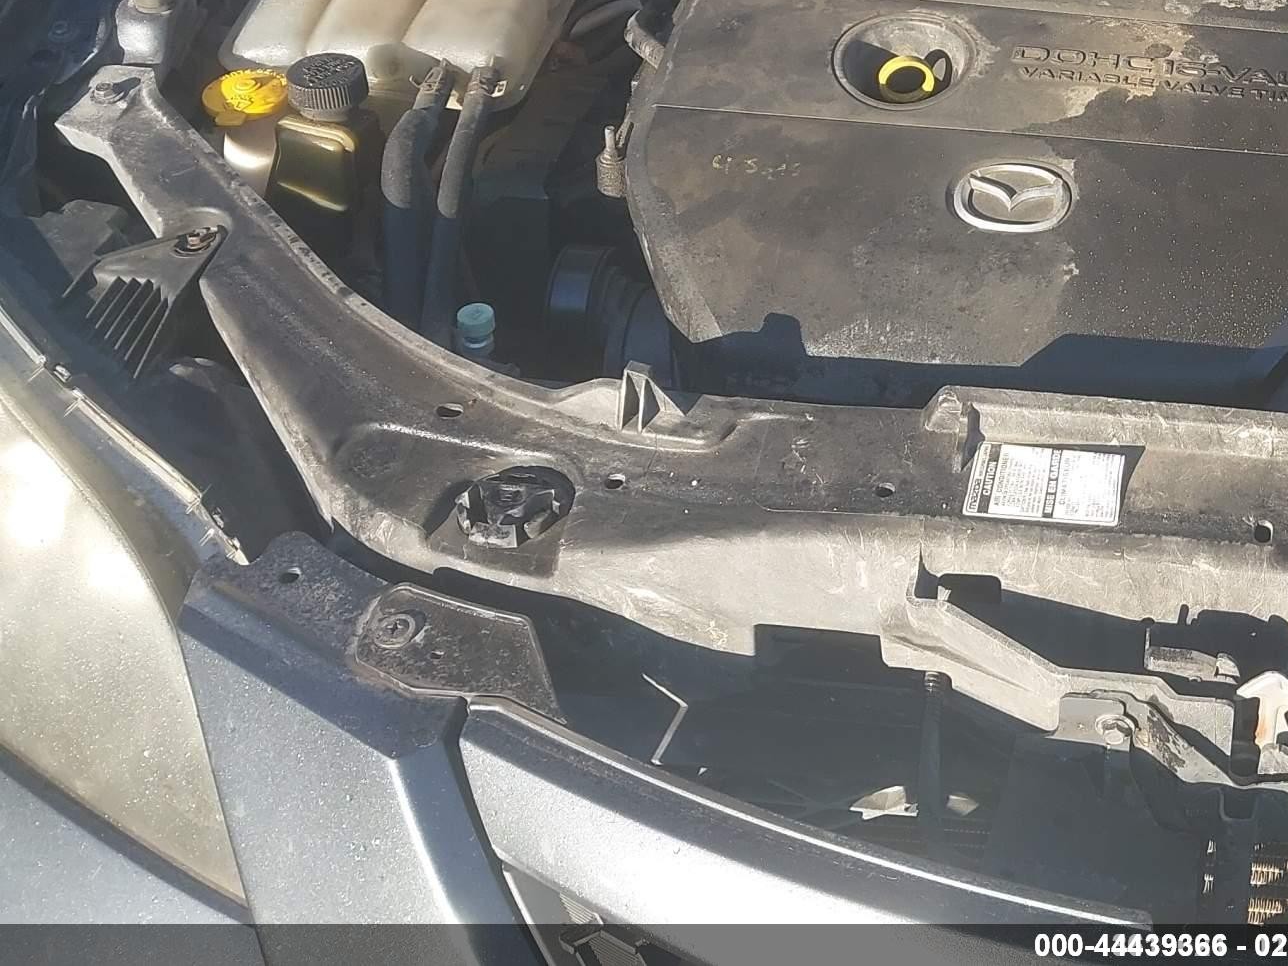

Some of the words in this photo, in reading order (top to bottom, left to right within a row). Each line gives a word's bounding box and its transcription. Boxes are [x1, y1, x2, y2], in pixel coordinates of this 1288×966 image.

[1011, 45, 1154, 72] DOHC
[1019, 66, 1155, 88] VARIABLE
[1163, 79, 1245, 99] VALVE
[982, 461, 998, 496] CAUTION
